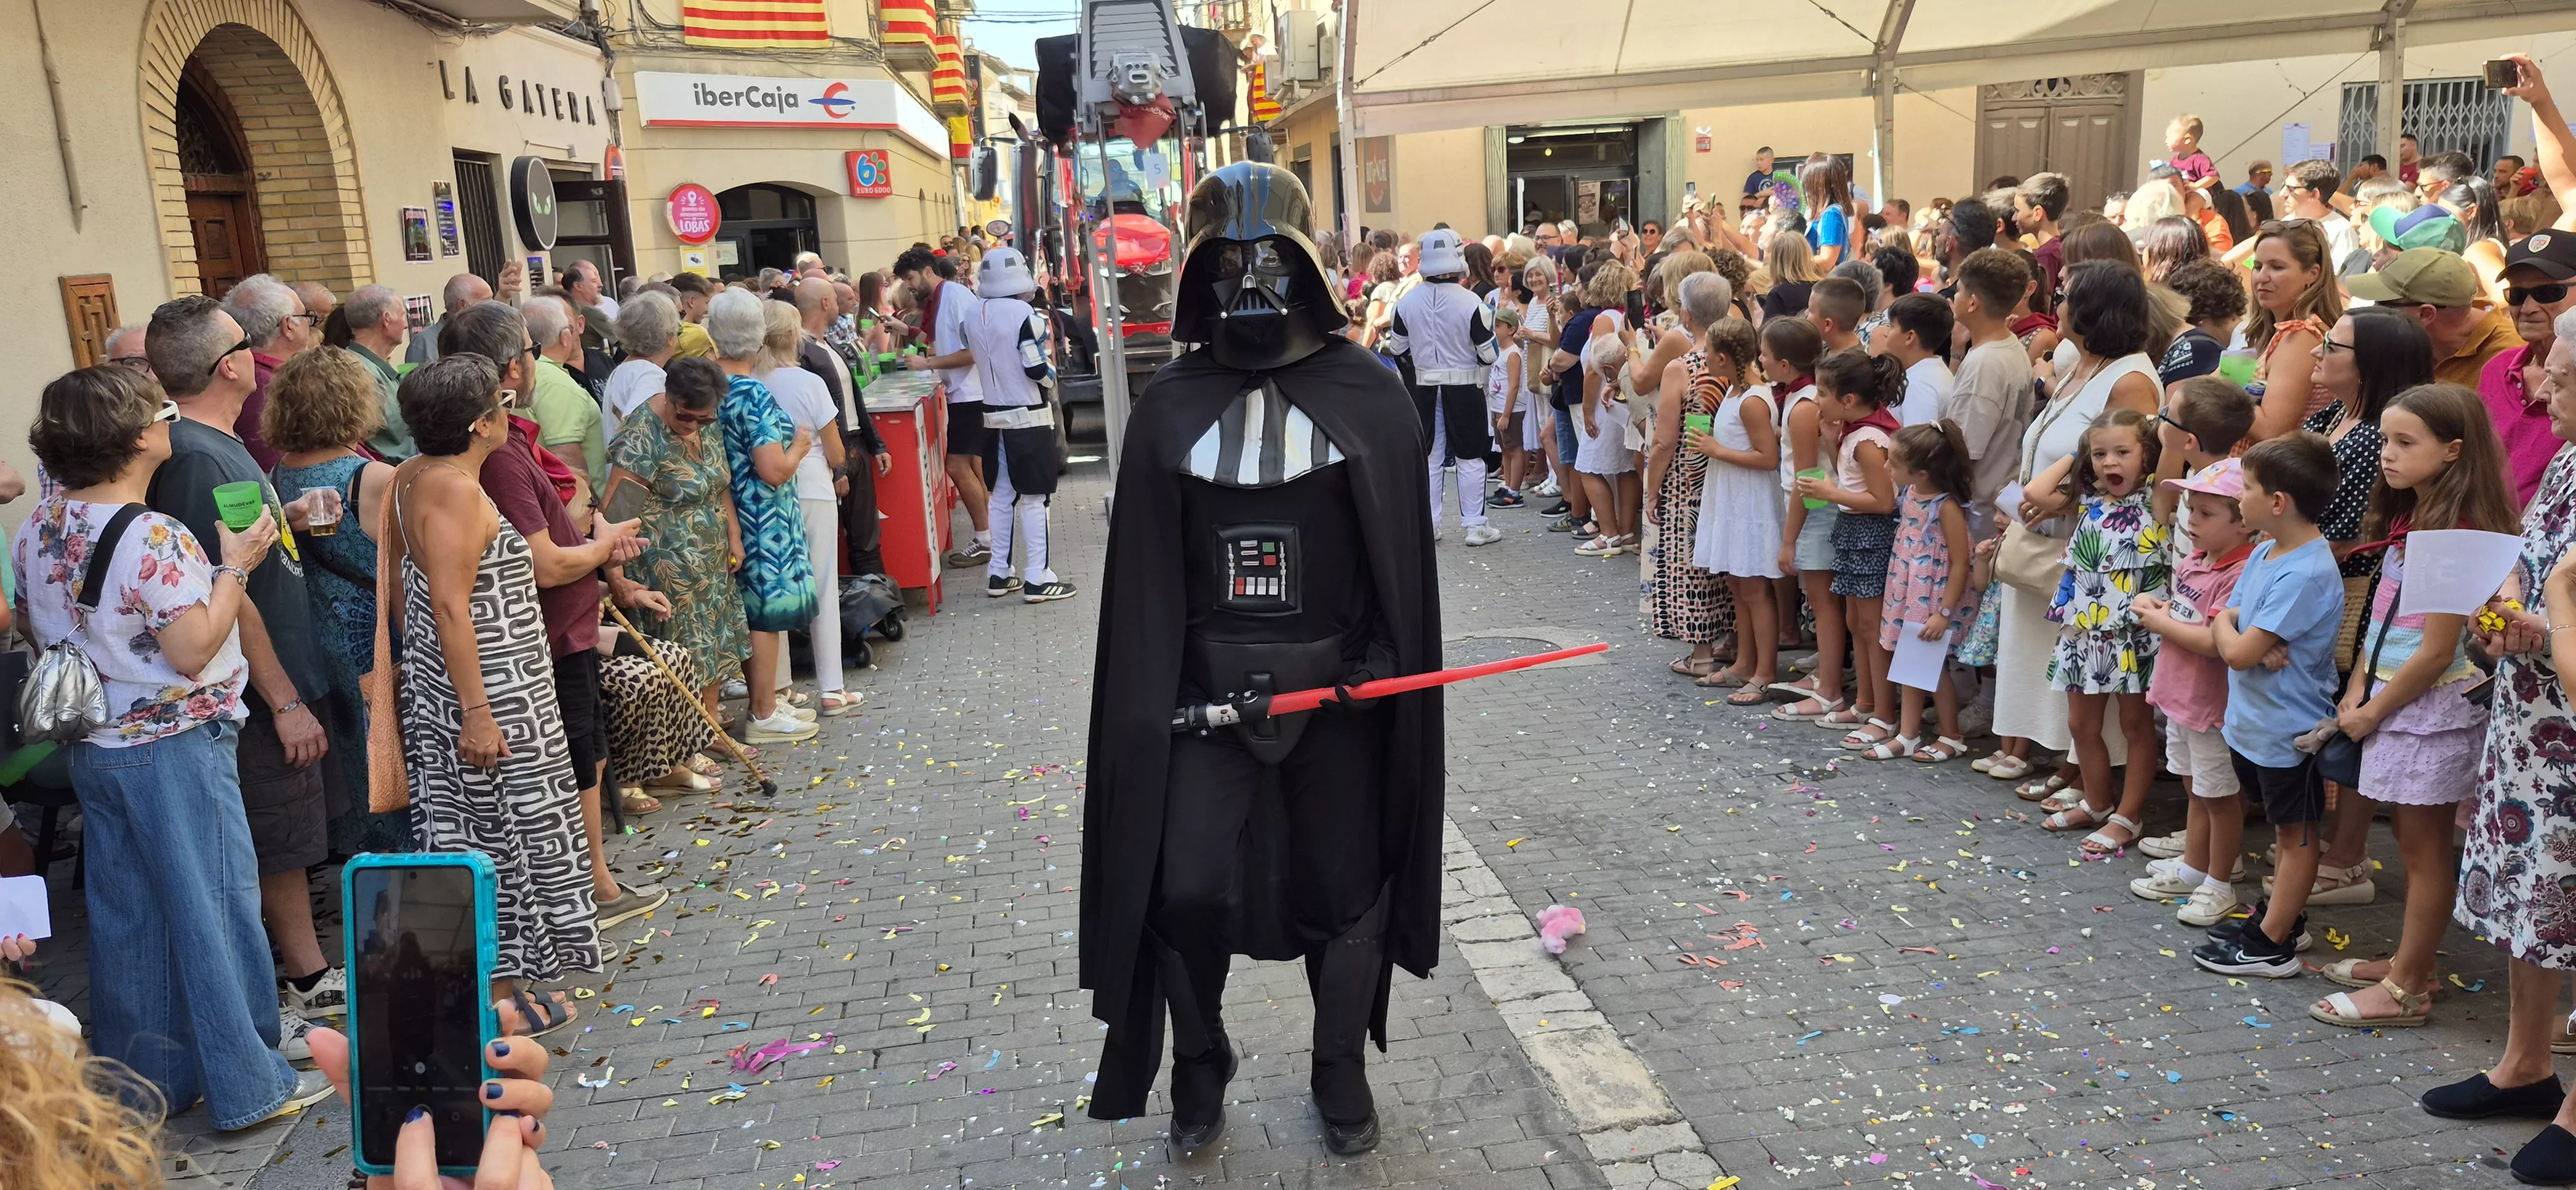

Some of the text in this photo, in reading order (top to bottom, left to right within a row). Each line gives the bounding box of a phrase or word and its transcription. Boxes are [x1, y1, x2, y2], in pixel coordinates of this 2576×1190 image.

[439, 60, 596, 126] LA GATERA
[693, 82, 799, 114] iberCaja
[1153, 164, 1162, 175] 5
[679, 219, 710, 233] LOBAS
